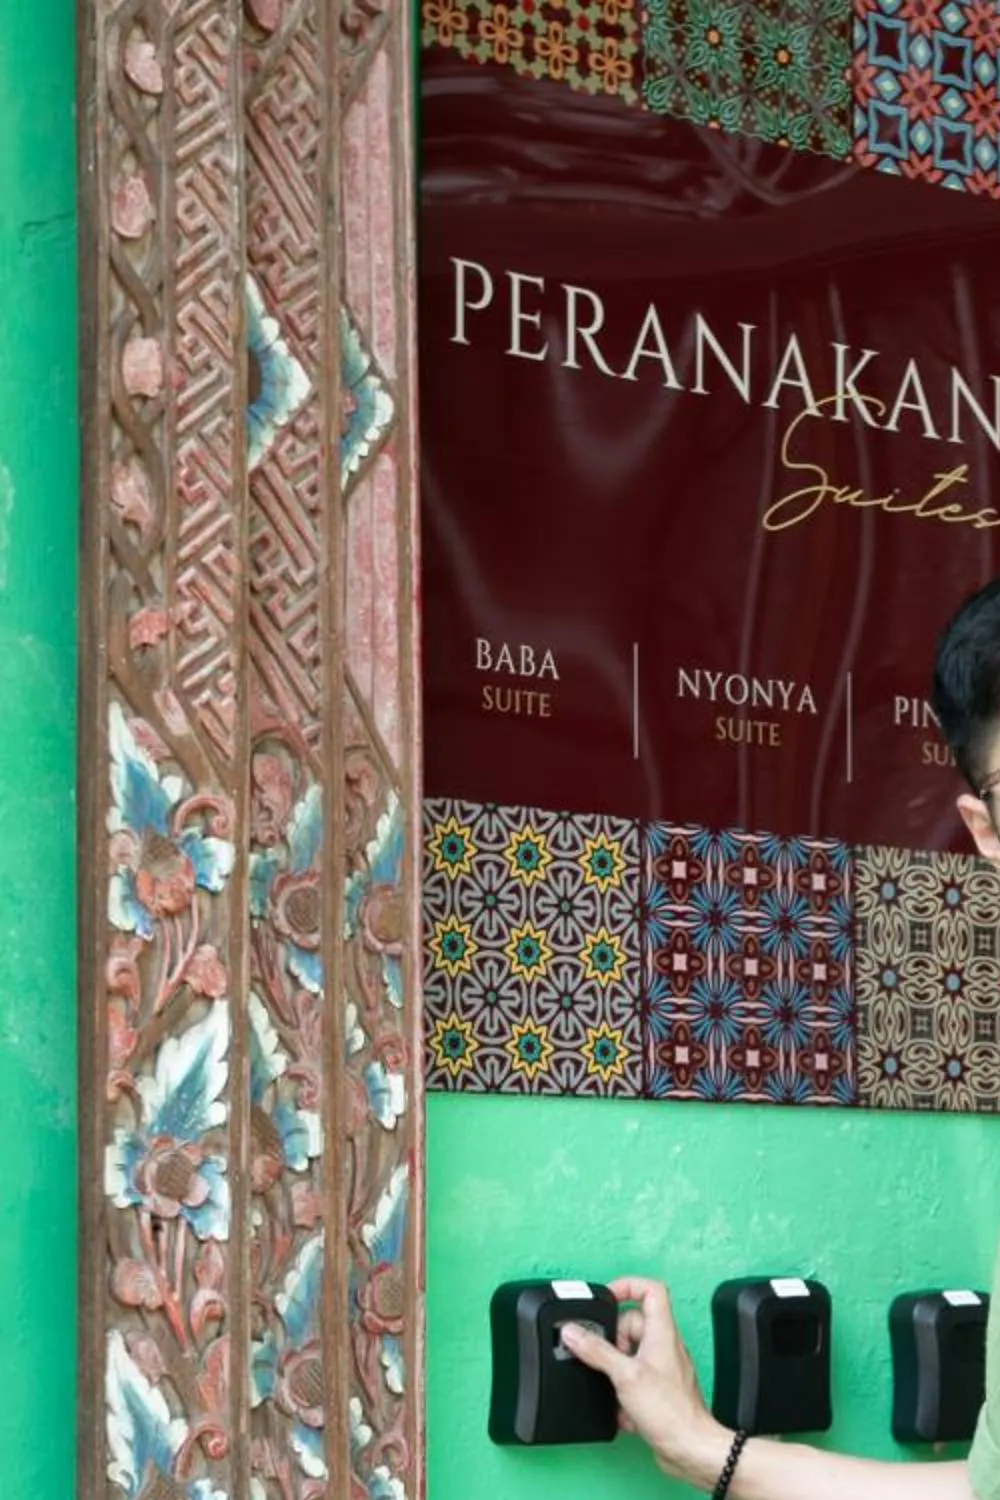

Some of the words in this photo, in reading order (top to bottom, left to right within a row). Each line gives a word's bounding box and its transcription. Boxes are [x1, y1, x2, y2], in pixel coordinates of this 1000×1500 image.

[476, 637, 560, 681] BABA
[482, 685, 553, 718] SUITE
[677, 666, 818, 715] NYONYA
[715, 716, 782, 747] SUITE
